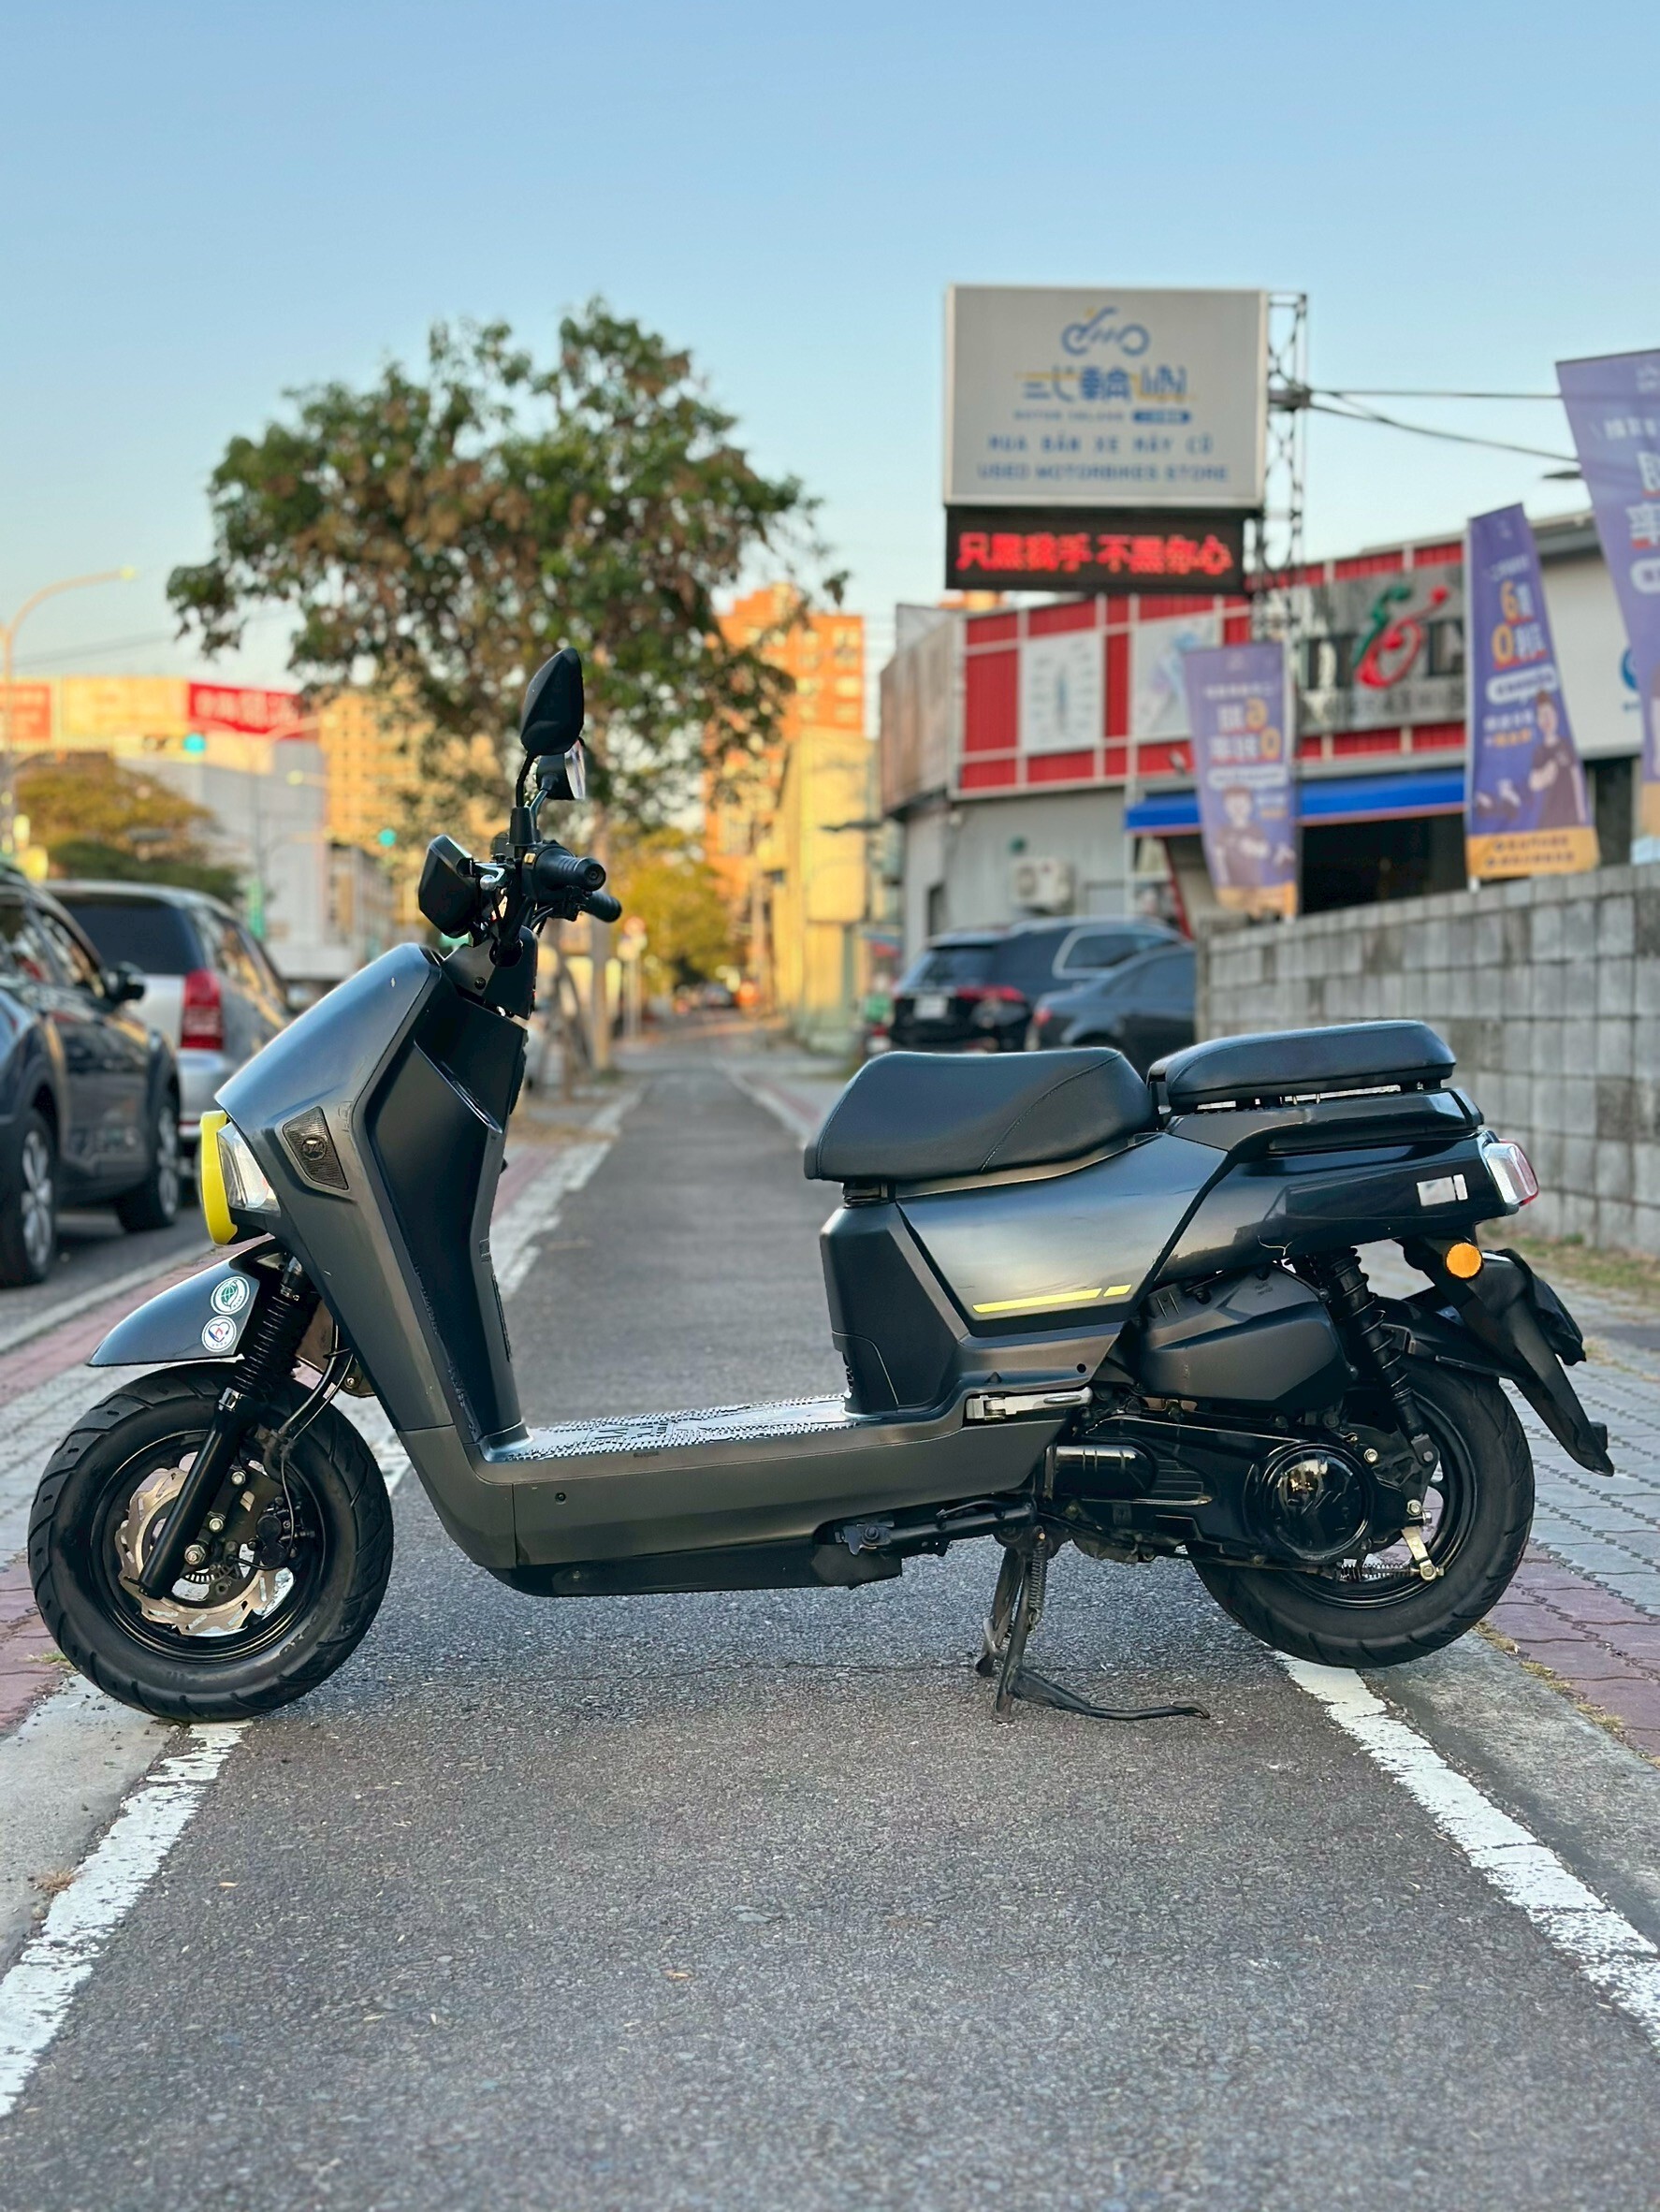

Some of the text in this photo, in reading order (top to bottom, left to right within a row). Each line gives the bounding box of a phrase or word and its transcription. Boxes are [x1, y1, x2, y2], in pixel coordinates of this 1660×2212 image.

[978, 462, 1230, 483] USED MOTORBIKES STORE
